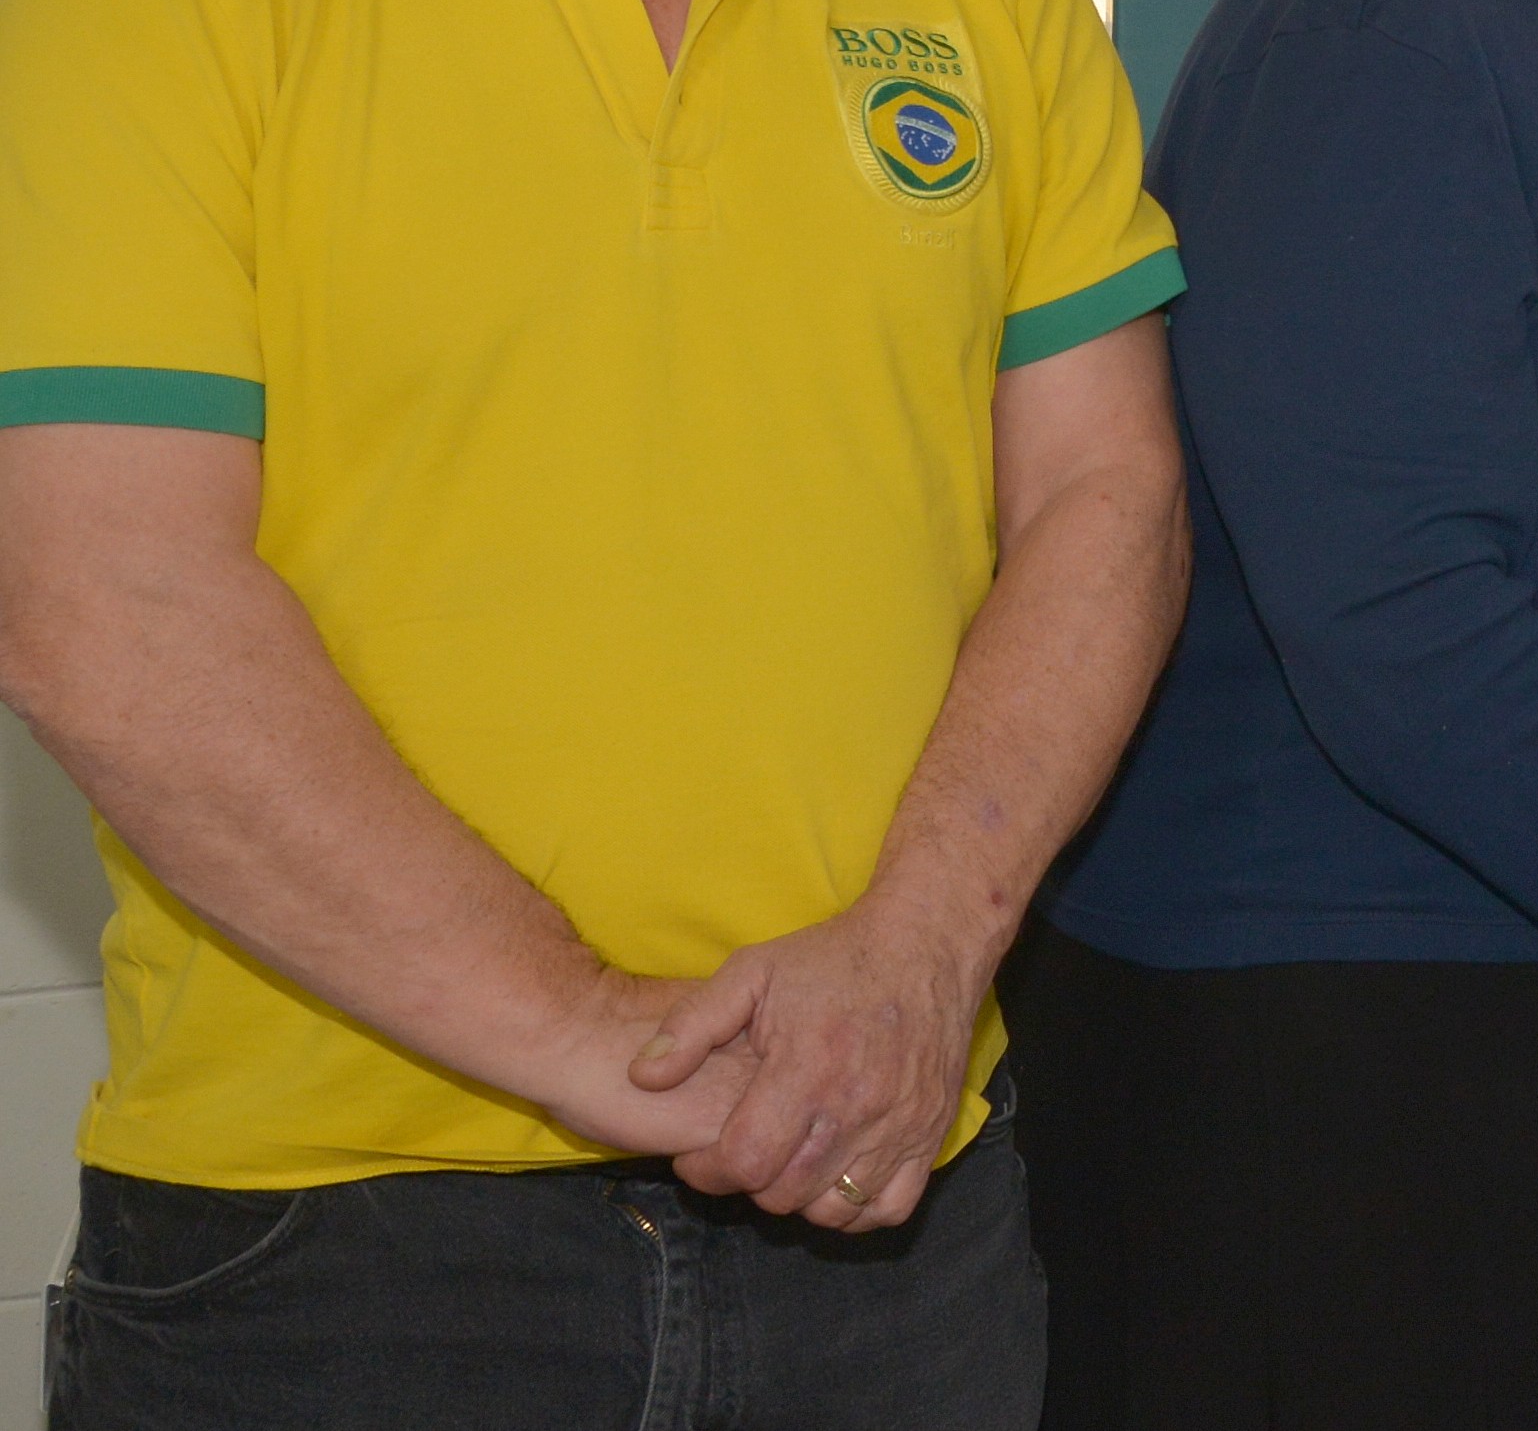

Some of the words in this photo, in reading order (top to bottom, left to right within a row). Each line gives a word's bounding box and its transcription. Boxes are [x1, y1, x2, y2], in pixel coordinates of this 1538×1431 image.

[830, 27, 959, 60] BOSS
[842, 54, 898, 70] HUGO
[908, 59, 963, 76] BOSS
